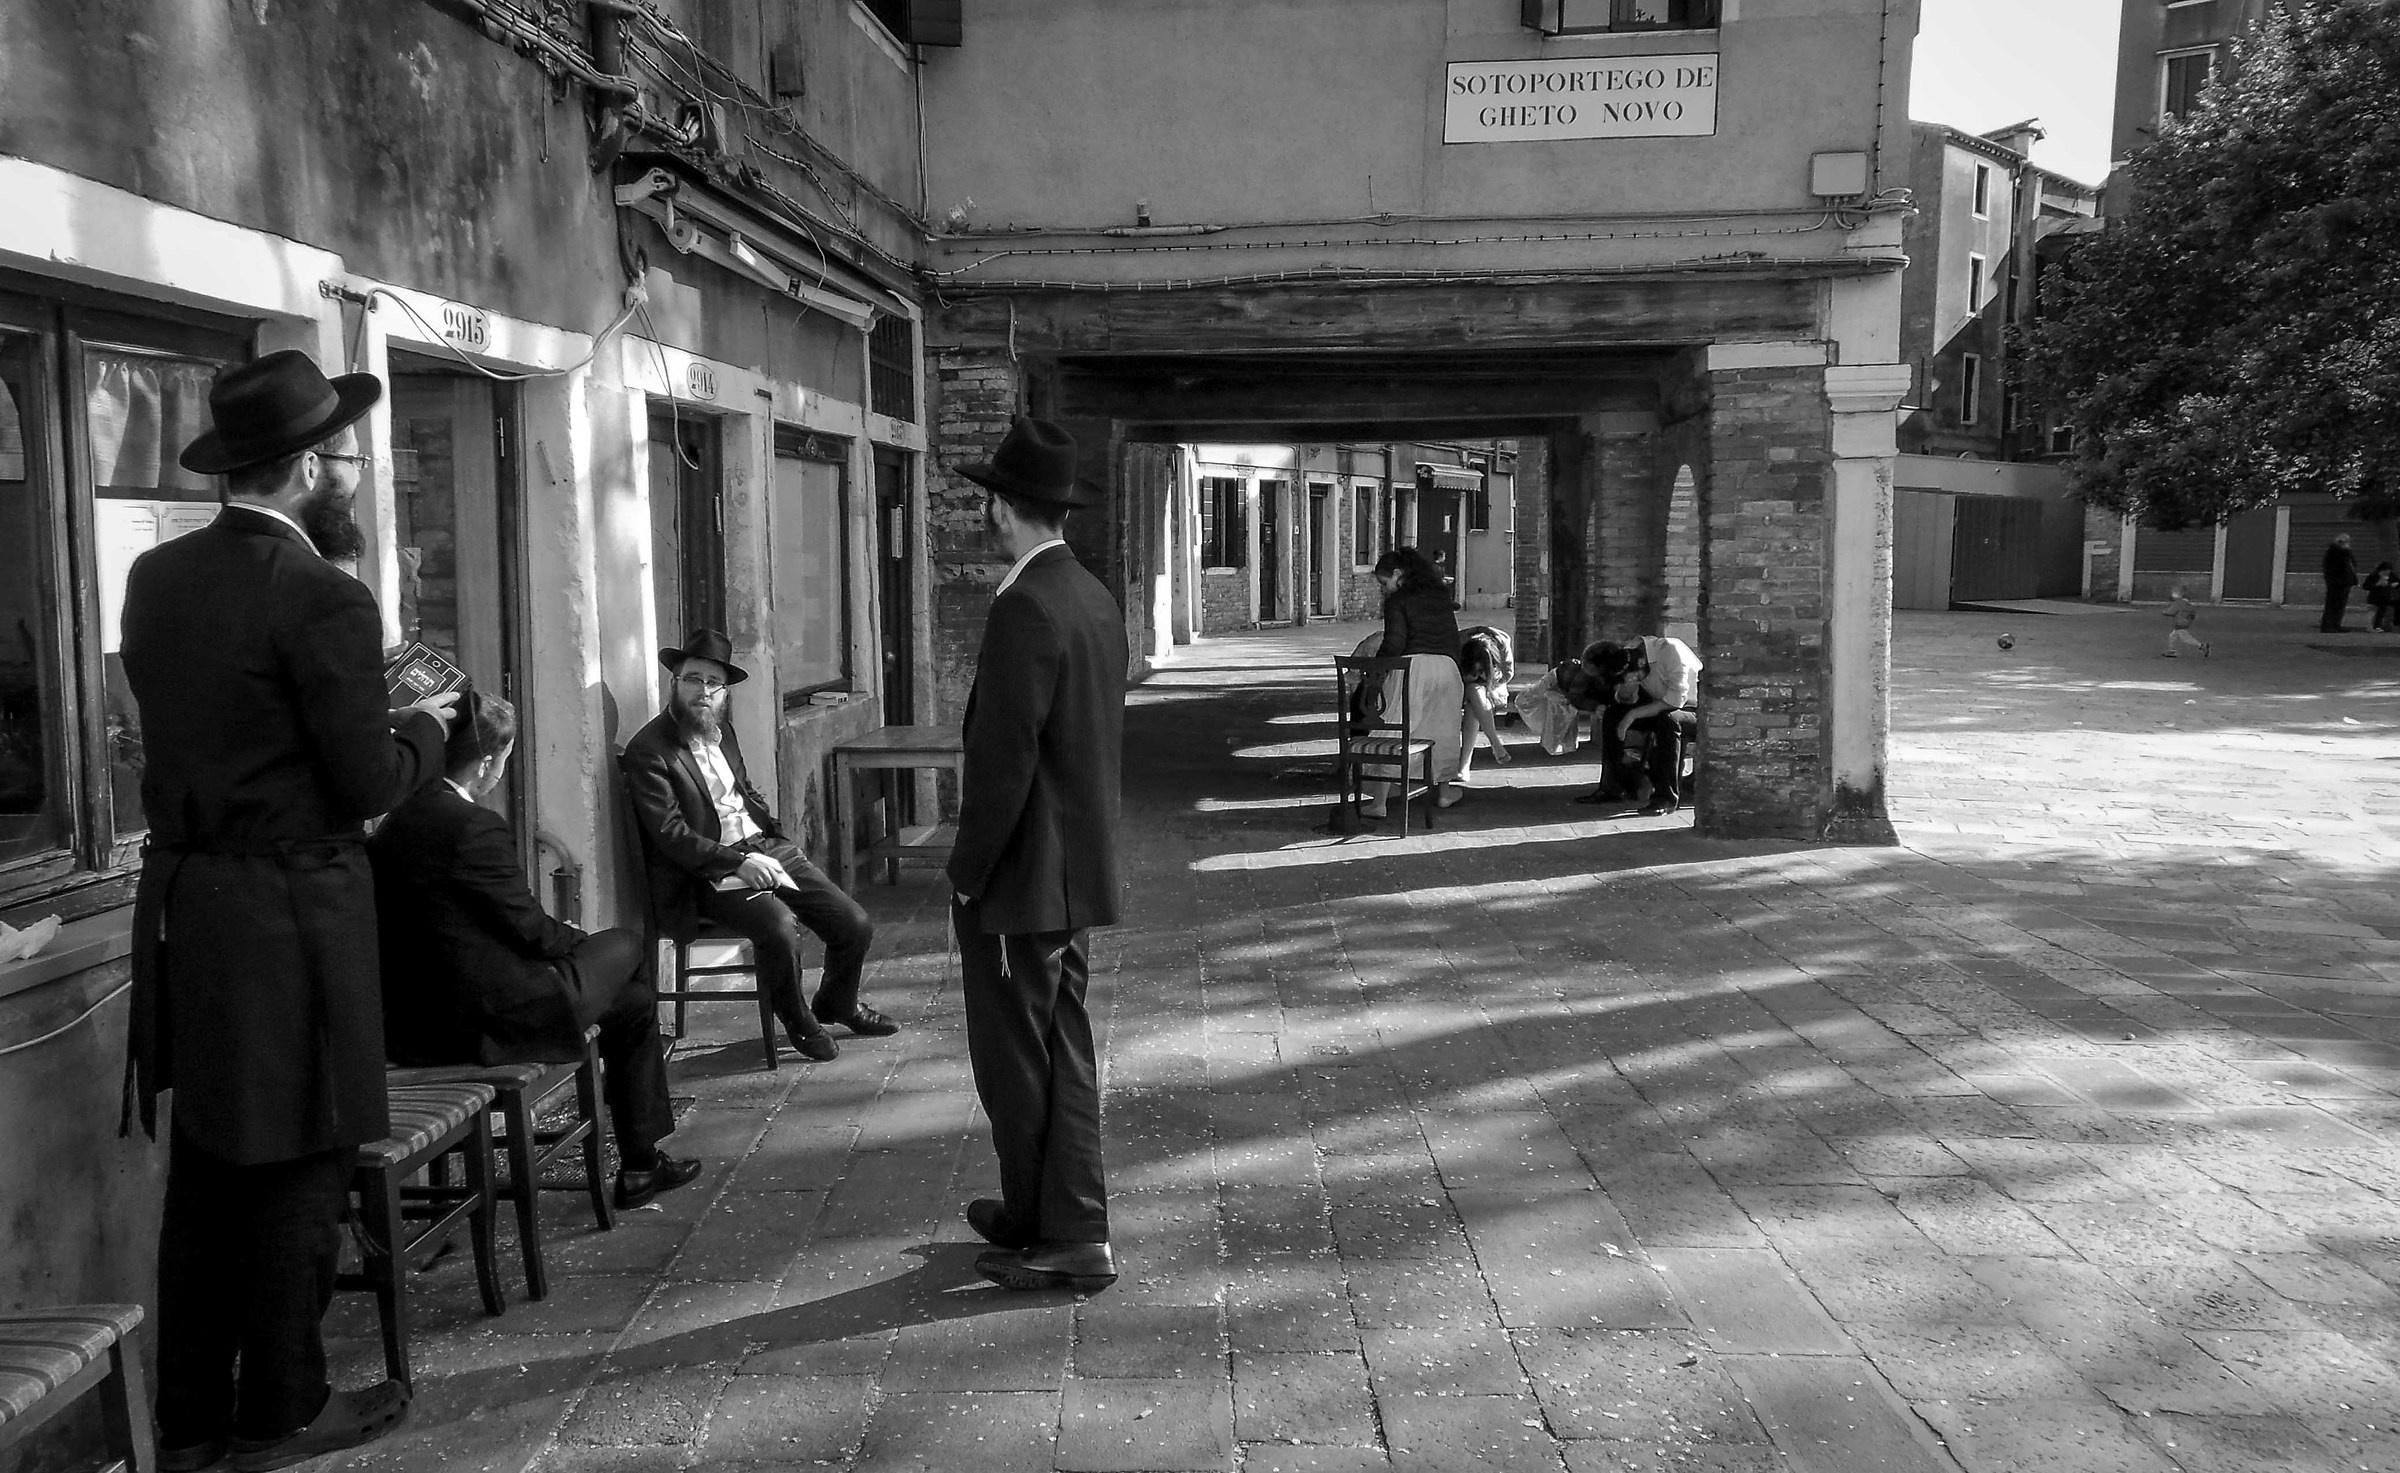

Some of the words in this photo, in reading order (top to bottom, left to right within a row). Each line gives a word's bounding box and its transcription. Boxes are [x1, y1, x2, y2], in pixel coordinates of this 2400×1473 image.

[1452, 68, 1665, 95] SOTOPORTEGO
[1675, 67, 1714, 89] DE
[1479, 104, 1577, 127] GHETO
[1603, 101, 1684, 124] NOVO
[443, 307, 485, 345] 2915
[689, 367, 714, 395] 2914
